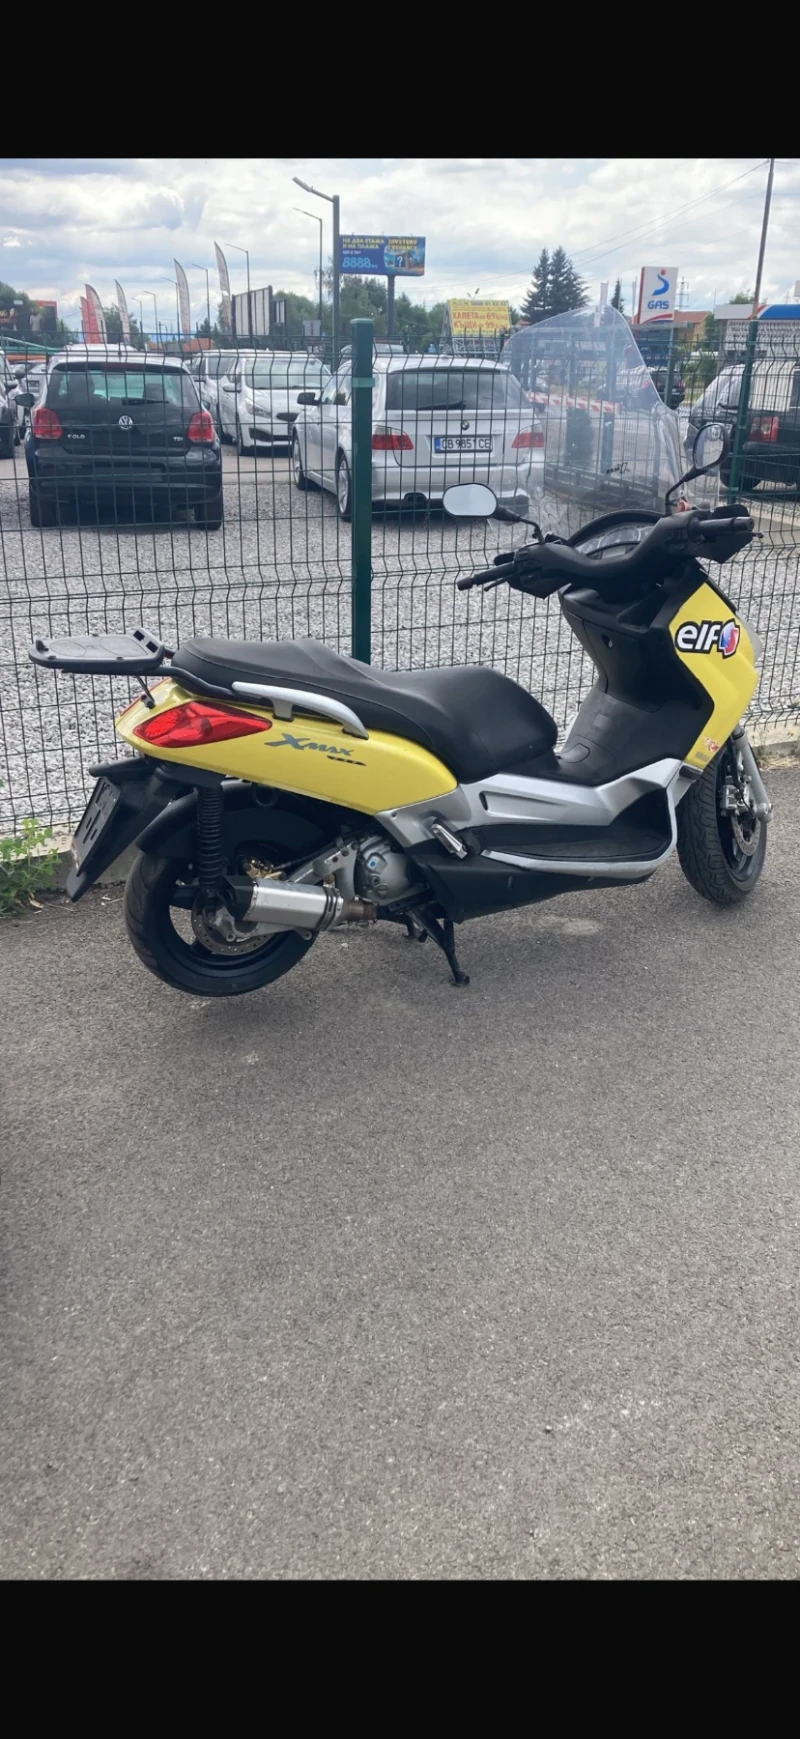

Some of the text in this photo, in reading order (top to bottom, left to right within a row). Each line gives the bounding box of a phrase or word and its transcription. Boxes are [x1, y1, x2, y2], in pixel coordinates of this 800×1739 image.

[648, 300, 669, 309] GAS
[479, 438, 490, 448] CE
[676, 623, 720, 650] elf
